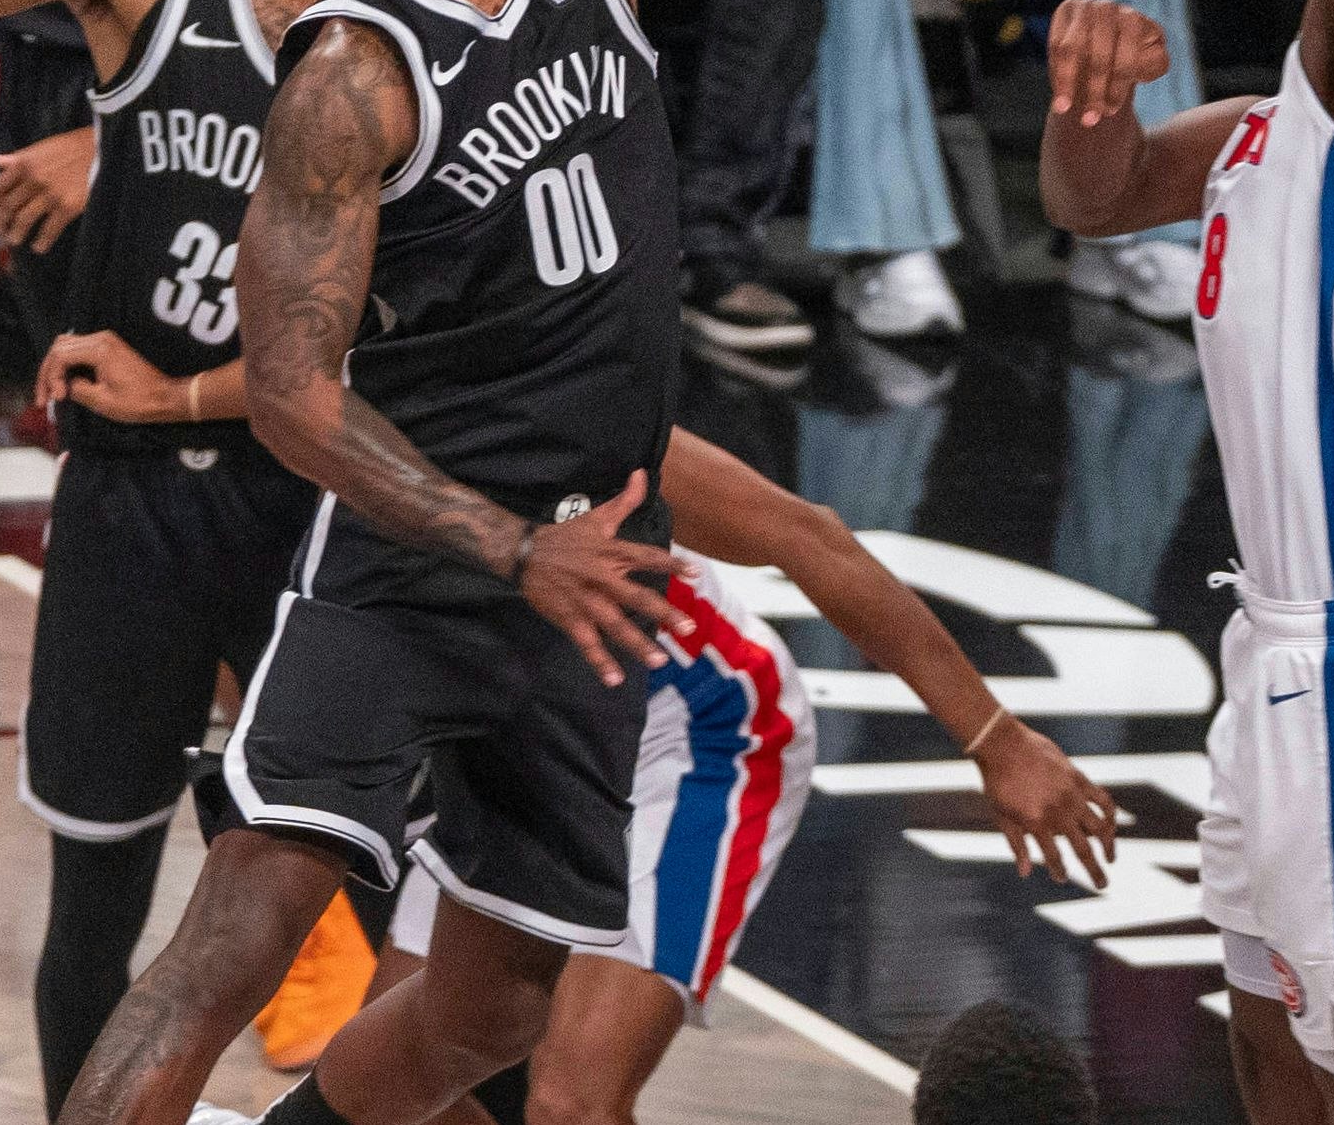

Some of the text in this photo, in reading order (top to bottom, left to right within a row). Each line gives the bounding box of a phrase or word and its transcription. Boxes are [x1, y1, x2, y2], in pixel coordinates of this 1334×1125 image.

[524, 151, 618, 286] 00
[1197, 212, 1228, 320] 8
[151, 220, 240, 345] 33
